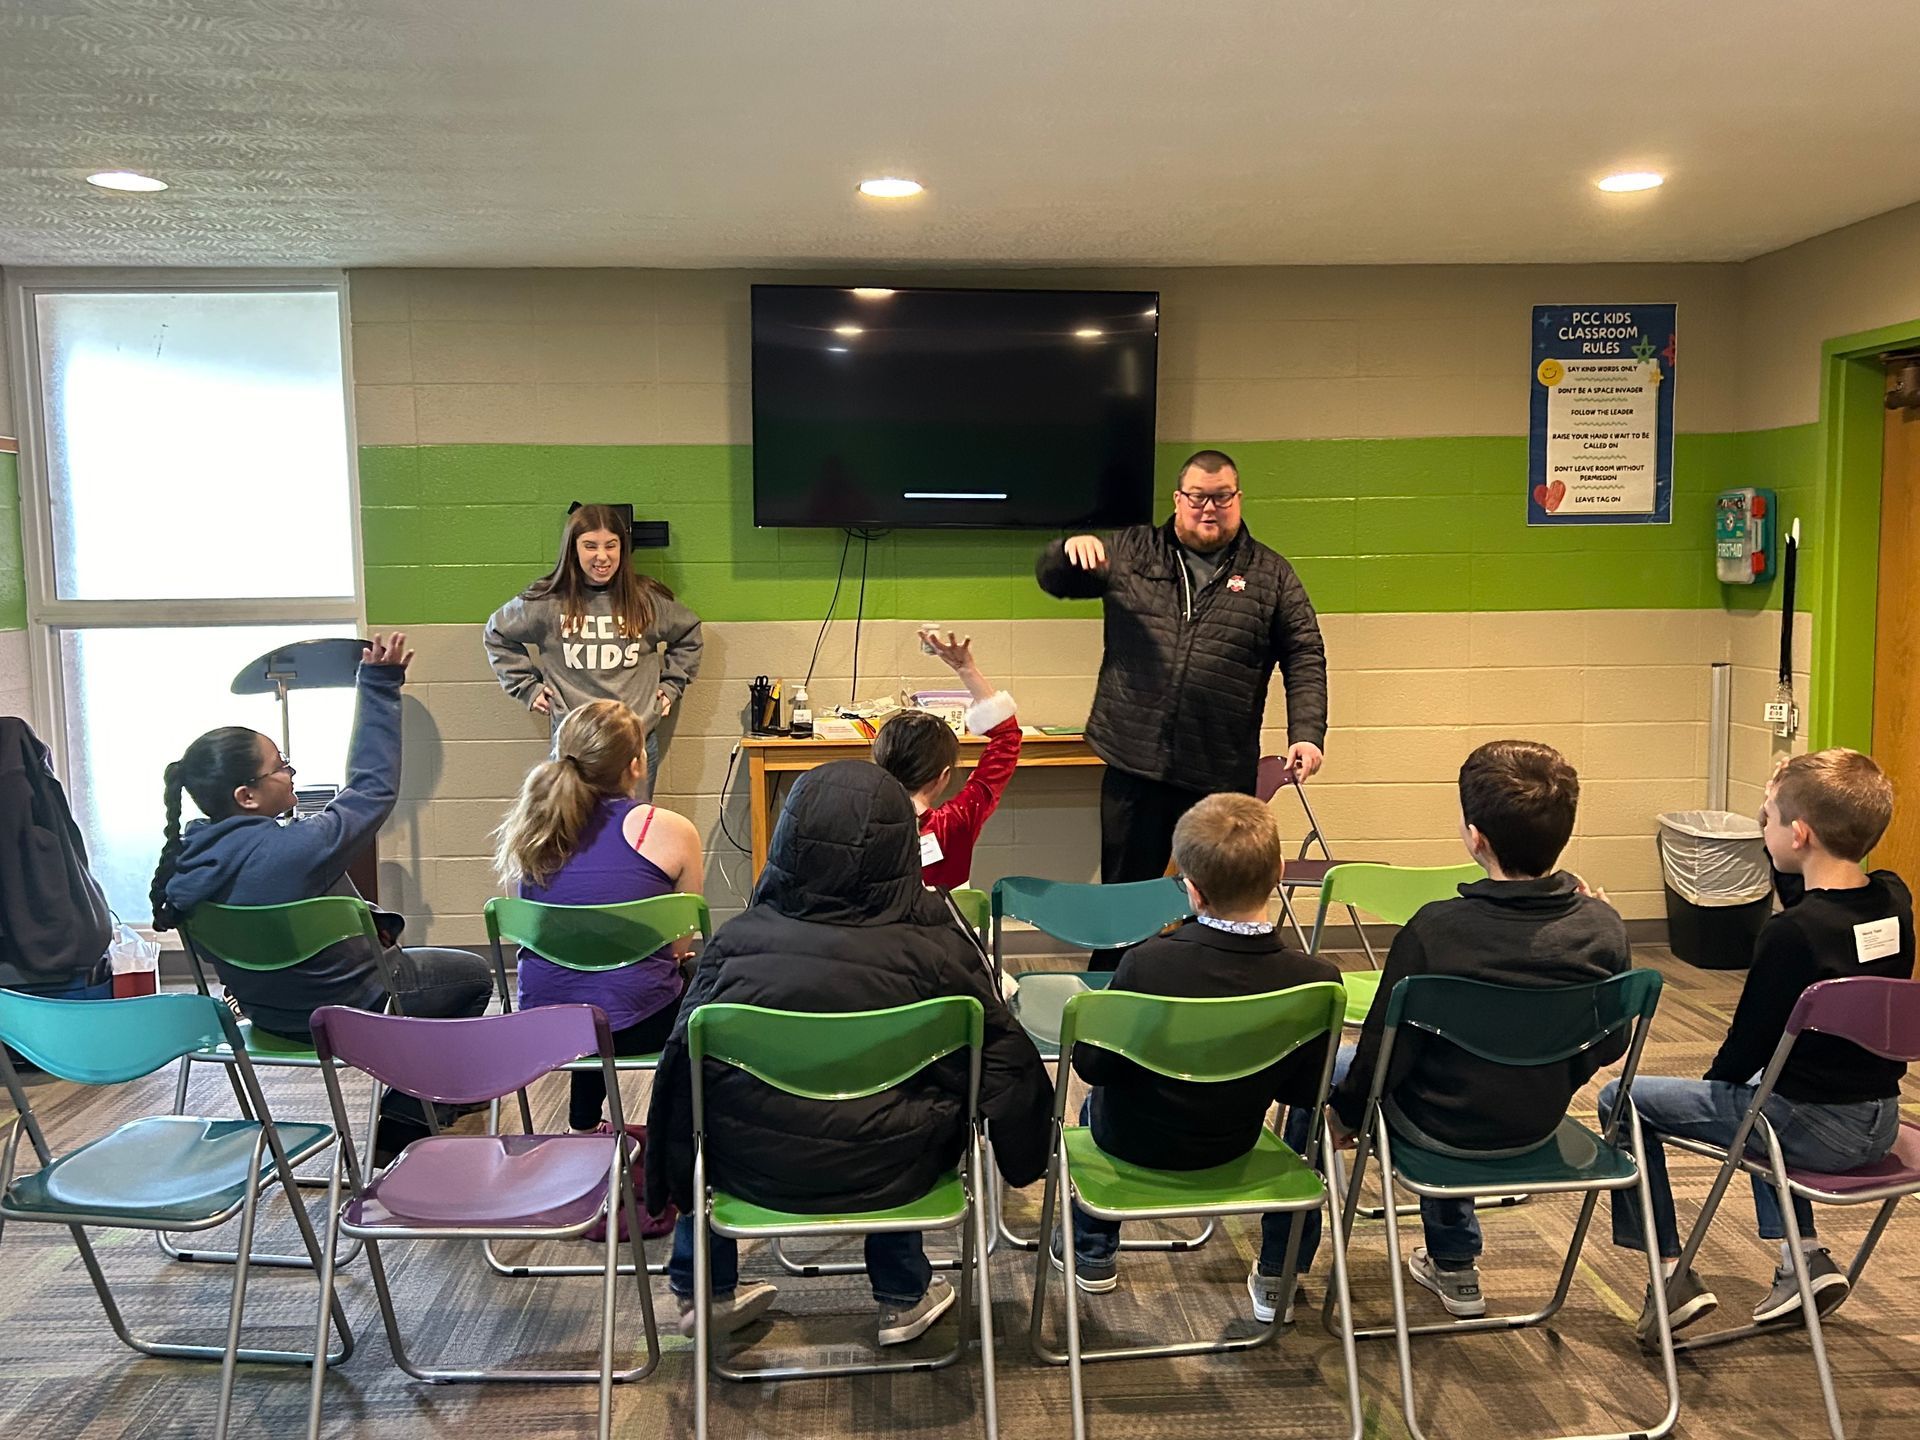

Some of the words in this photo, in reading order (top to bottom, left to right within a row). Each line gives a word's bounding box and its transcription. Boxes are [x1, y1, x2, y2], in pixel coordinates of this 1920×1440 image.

[1572, 312, 1600, 325] PCC
[1603, 312, 1632, 324] KIDS
[1558, 326, 1638, 340] CLASSROOM
[1582, 341, 1620, 354] RULES
[1598, 365, 1620, 373] WORDS
[1620, 365, 1638, 373] ONLY
[1616, 386, 1644, 394] INVADER
[1598, 408, 1610, 416] THE
[1610, 408, 1634, 416] LEADER
[1584, 442, 1608, 450] CALLED
[1616, 464, 1644, 472] WITHOUT
[562, 643, 640, 670] KIDS
